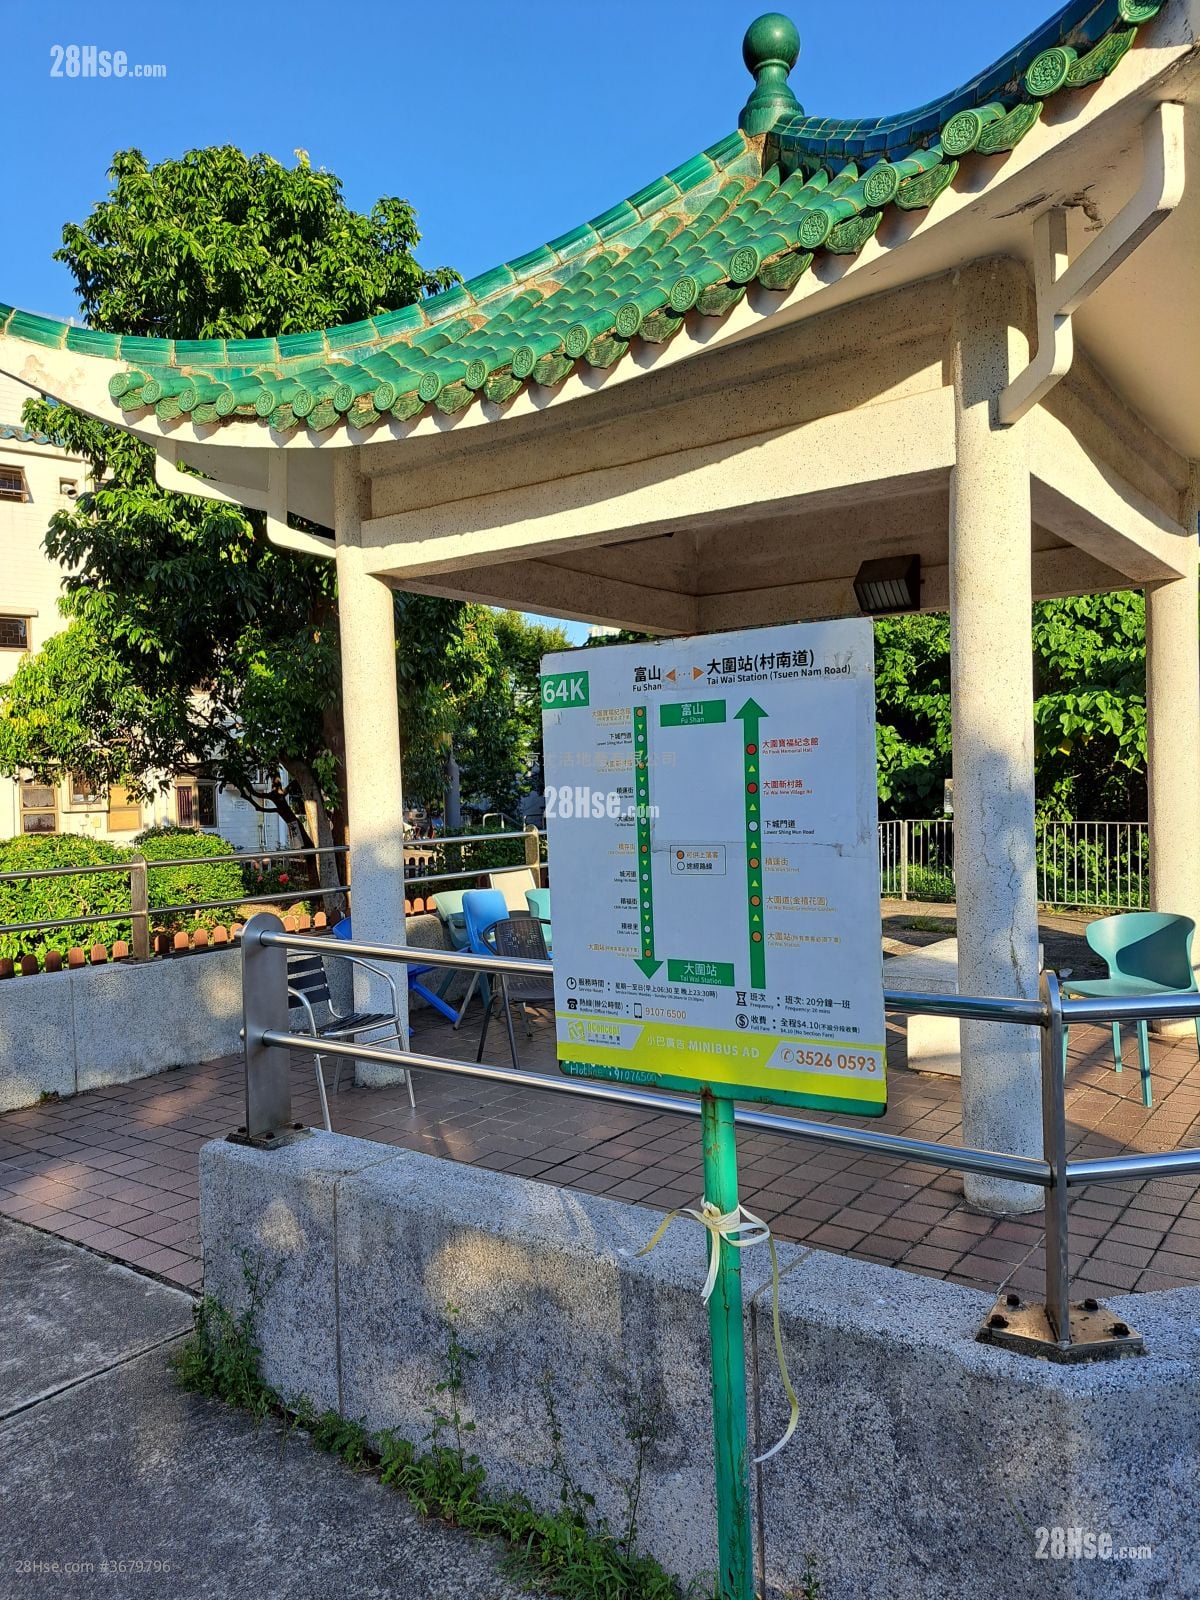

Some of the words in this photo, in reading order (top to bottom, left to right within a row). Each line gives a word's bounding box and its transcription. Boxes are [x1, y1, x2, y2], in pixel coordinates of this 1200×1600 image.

[706, 649, 815, 676] 大圍站(村南道)
[634, 665, 662, 683] 富山
[706, 677, 719, 685] Tai
[720, 675, 736, 684] Wai
[737, 672, 768, 683] Station
[769, 669, 799, 681] (Tsuen
[801, 668, 822, 677] Nam
[824, 664, 851, 675] Road)
[543, 677, 586, 704] 64K
[632, 684, 642, 692] Fu
[643, 682, 662, 692] Shan
[681, 702, 704, 717] 富山
[689, 716, 705, 724] Shan
[762, 737, 819, 748] 大圍寶福紀念館
[763, 779, 803, 789] 大圍新村路
[764, 820, 796, 829] 下城門道
[684, 962, 717, 977] 大圍站
[578, 977, 604, 988] 服務時間
[701, 976, 722, 985] Station
[750, 992, 767, 1002] 班次
[785, 995, 805, 1006] 班次:
[806, 997, 851, 1009] 20分鐘一班
[645, 1007, 665, 1017] 9107
[666, 1008, 687, 1020] 6500
[750, 1015, 767, 1025] 收費
[647, 1035, 685, 1049] 小巴廣告
[688, 1041, 738, 1057] MINIBUS
[742, 1045, 760, 1058] AD
[796, 1049, 833, 1068] 3526
[837, 1054, 876, 1073] 0593
